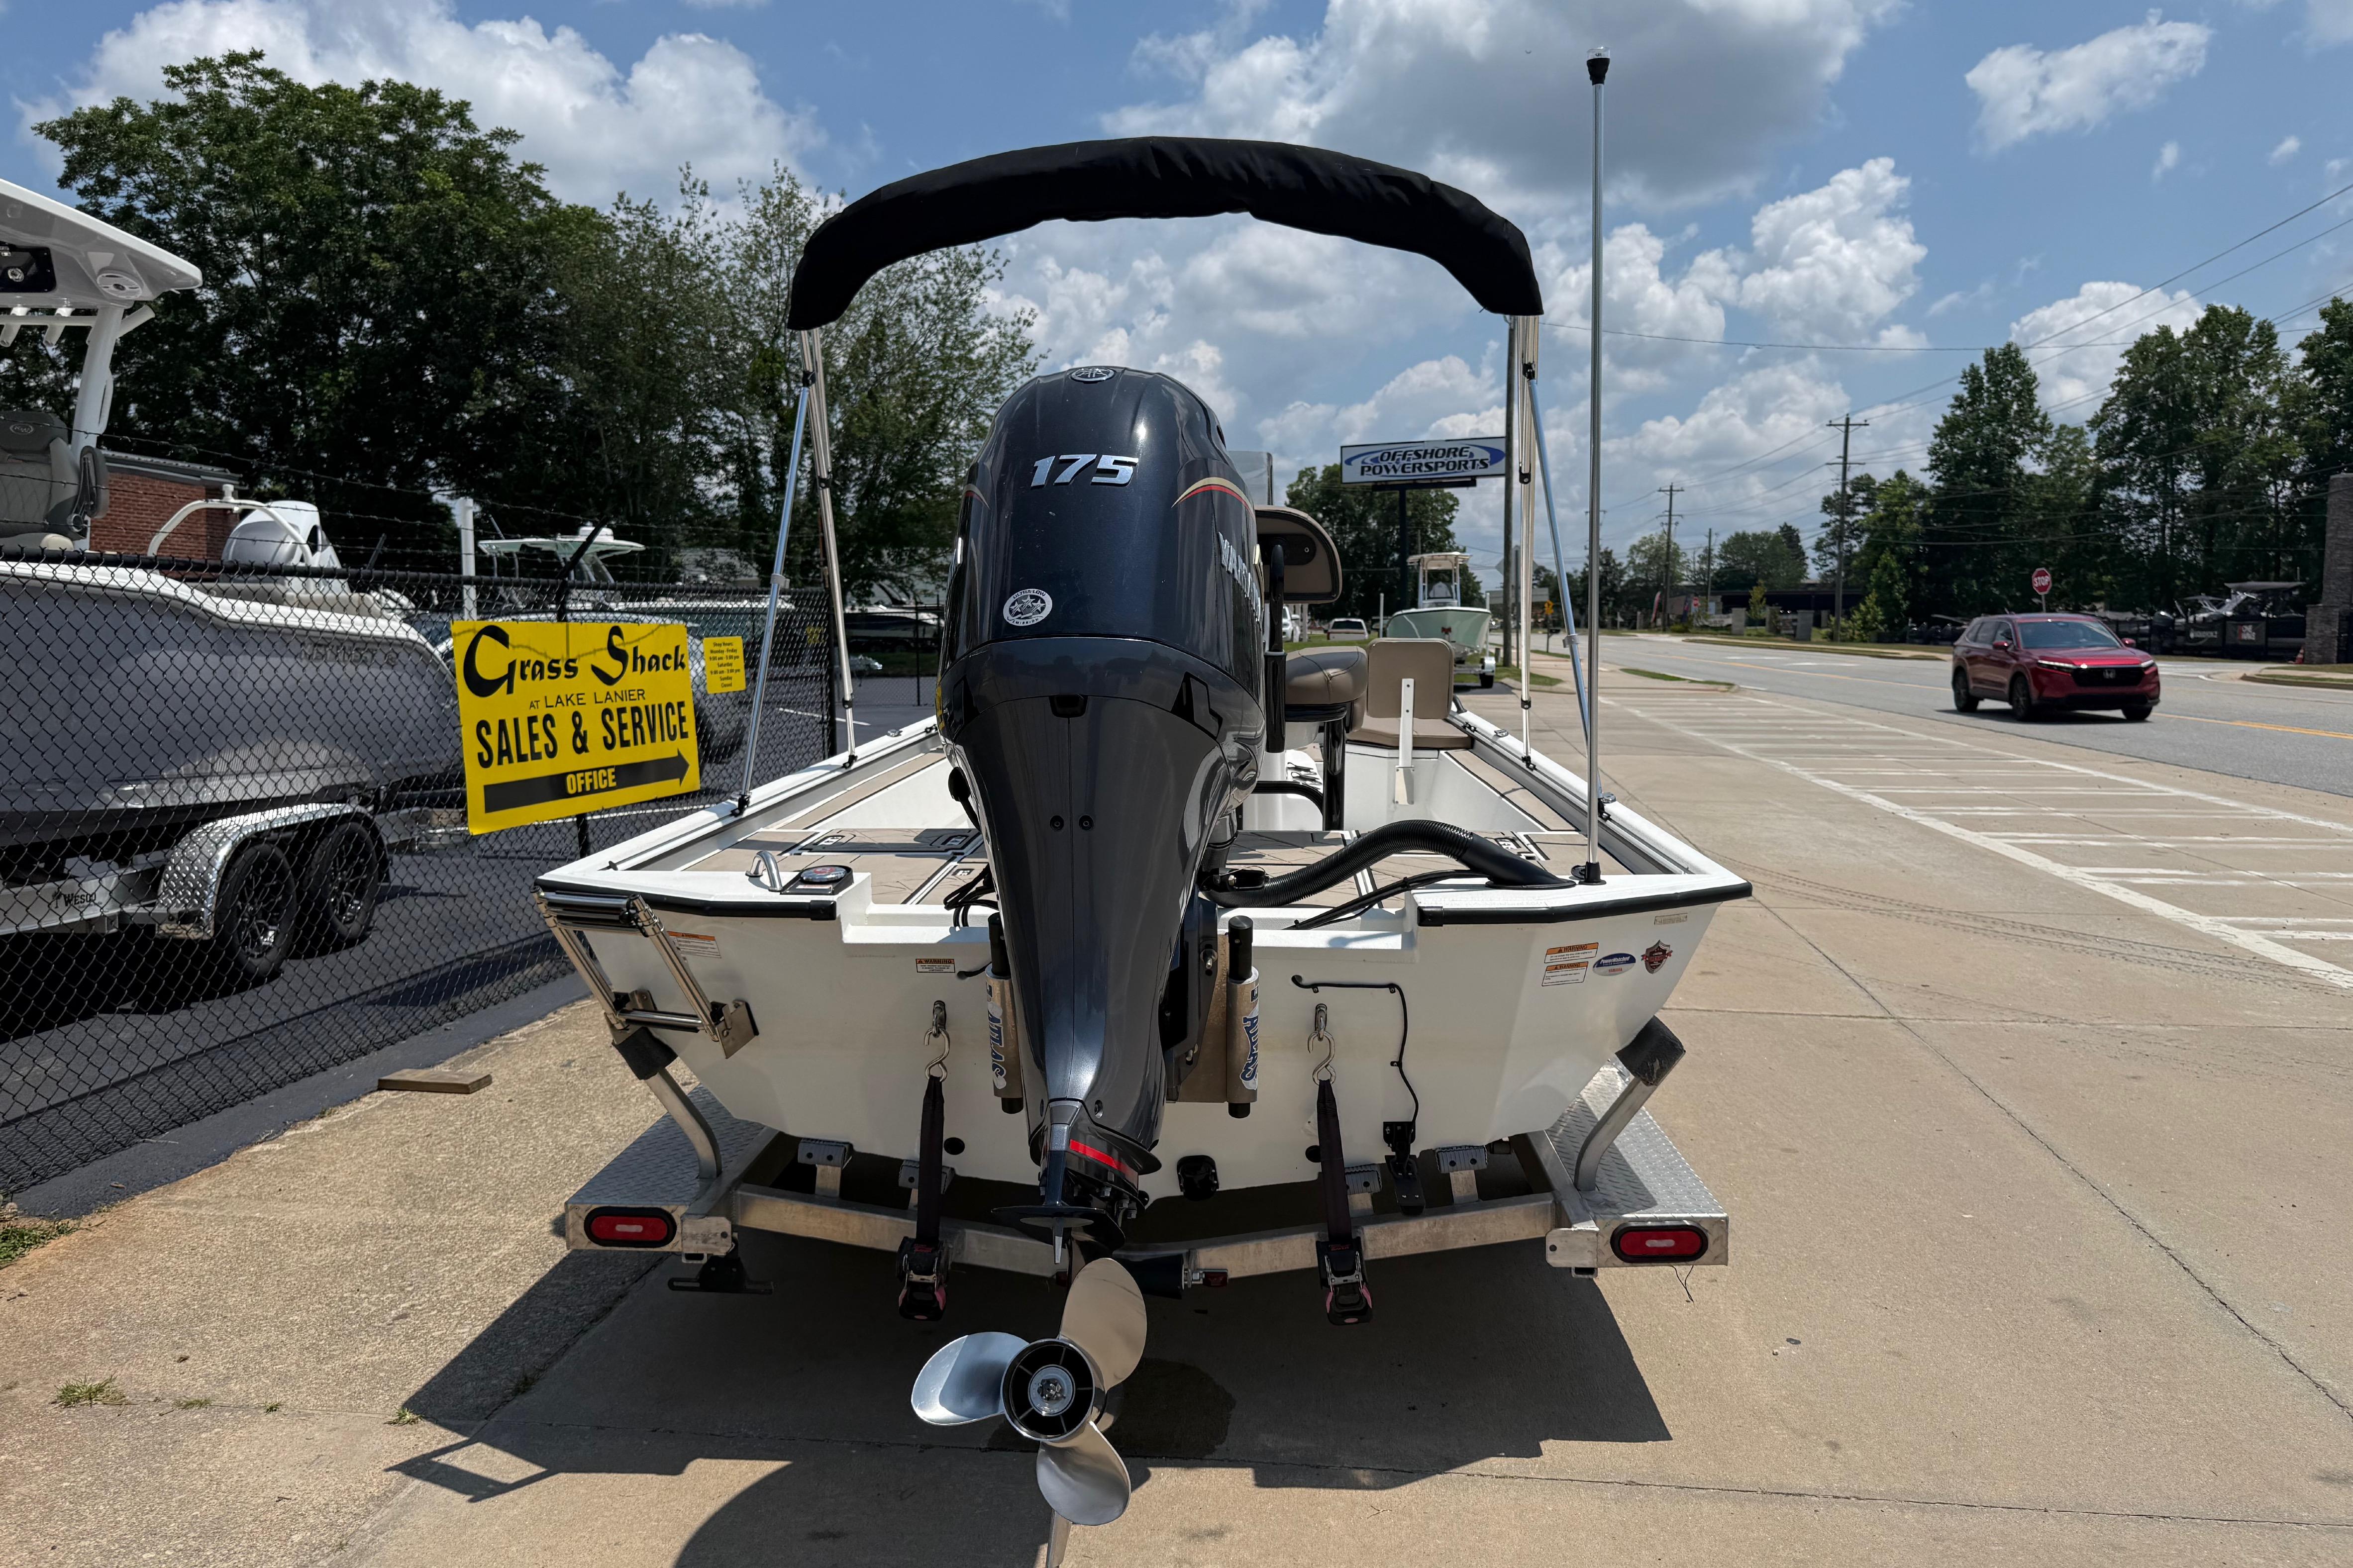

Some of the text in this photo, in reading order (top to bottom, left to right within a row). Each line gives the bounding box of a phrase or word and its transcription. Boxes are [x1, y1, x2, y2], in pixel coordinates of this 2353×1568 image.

[1380, 447, 1470, 462] OFFSHORE
[1030, 454, 1139, 489] 175
[1360, 458, 1489, 476] POWERSPORTS
[2034, 576, 2050, 587] STOP
[464, 625, 686, 697] Grass Shack
[529, 689, 645, 710] AT LAKE LANIER
[476, 700, 689, 768] SALES & SERVICE
[566, 767, 616, 794] OFFICE
